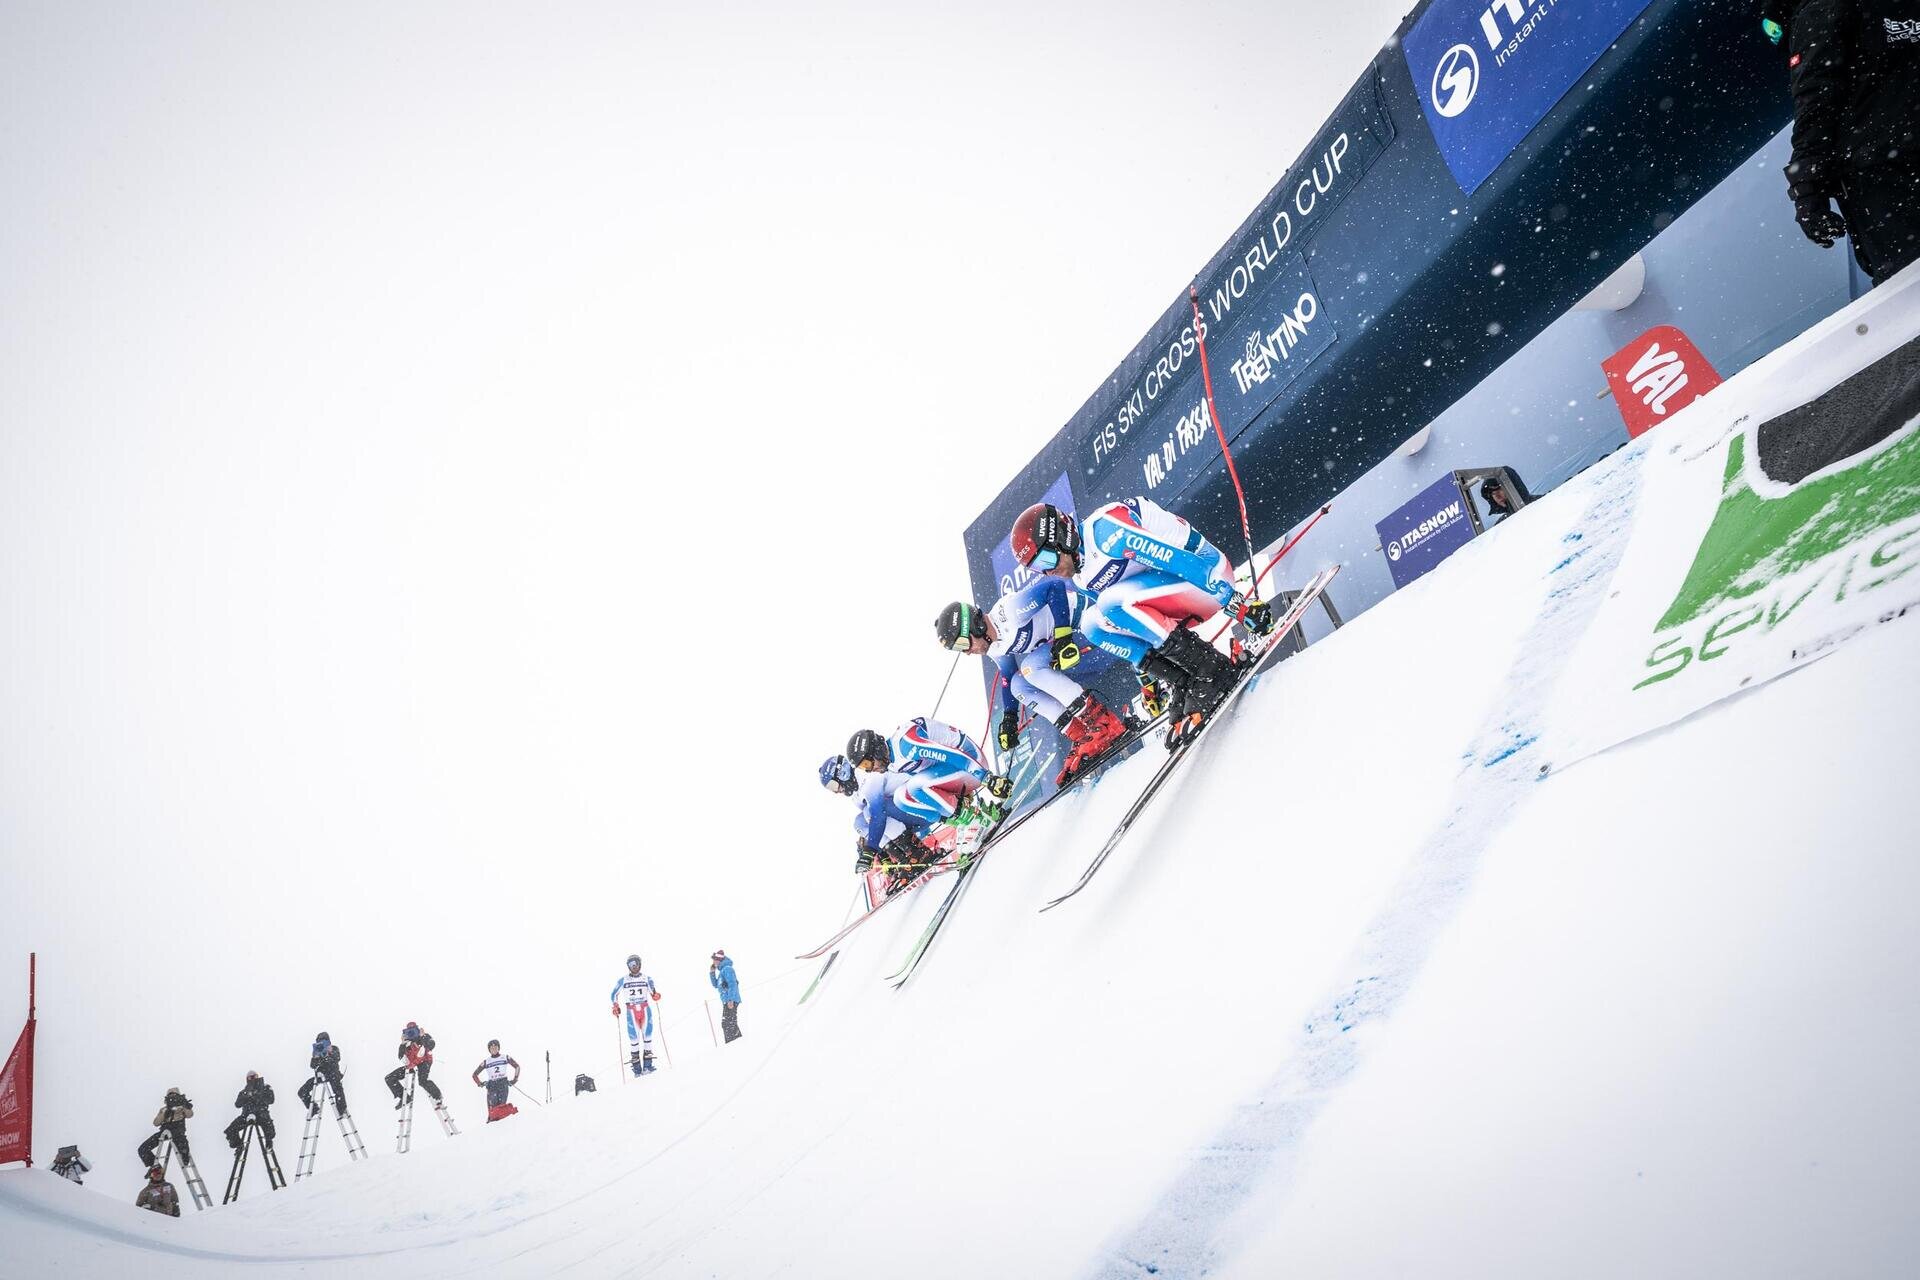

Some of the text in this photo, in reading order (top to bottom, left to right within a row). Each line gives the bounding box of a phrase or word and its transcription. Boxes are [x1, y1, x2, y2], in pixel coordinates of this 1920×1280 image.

[1479, 0, 1536, 51] IT
[1494, 3, 1548, 68] Instant
[1093, 132, 1349, 464] FIS SKI CROSS WORLD CUP
[1230, 292, 1317, 395] TRENTINO
[1625, 342, 1689, 415] VAL
[1143, 453, 1166, 490] VAL
[1175, 397, 1212, 456] FASSA
[1039, 517, 1047, 537] uvex
[1048, 516, 1056, 542] uvex
[1400, 500, 1461, 549] ITASNOW
[1125, 534, 1174, 563] COLMAR
[1015, 600, 1039, 615] Audi
[1099, 640, 1131, 659] COLMAR
[918, 748, 947, 763] COLMAR
[629, 988, 643, 996] 21
[494, 1066, 501, 1074] 2
